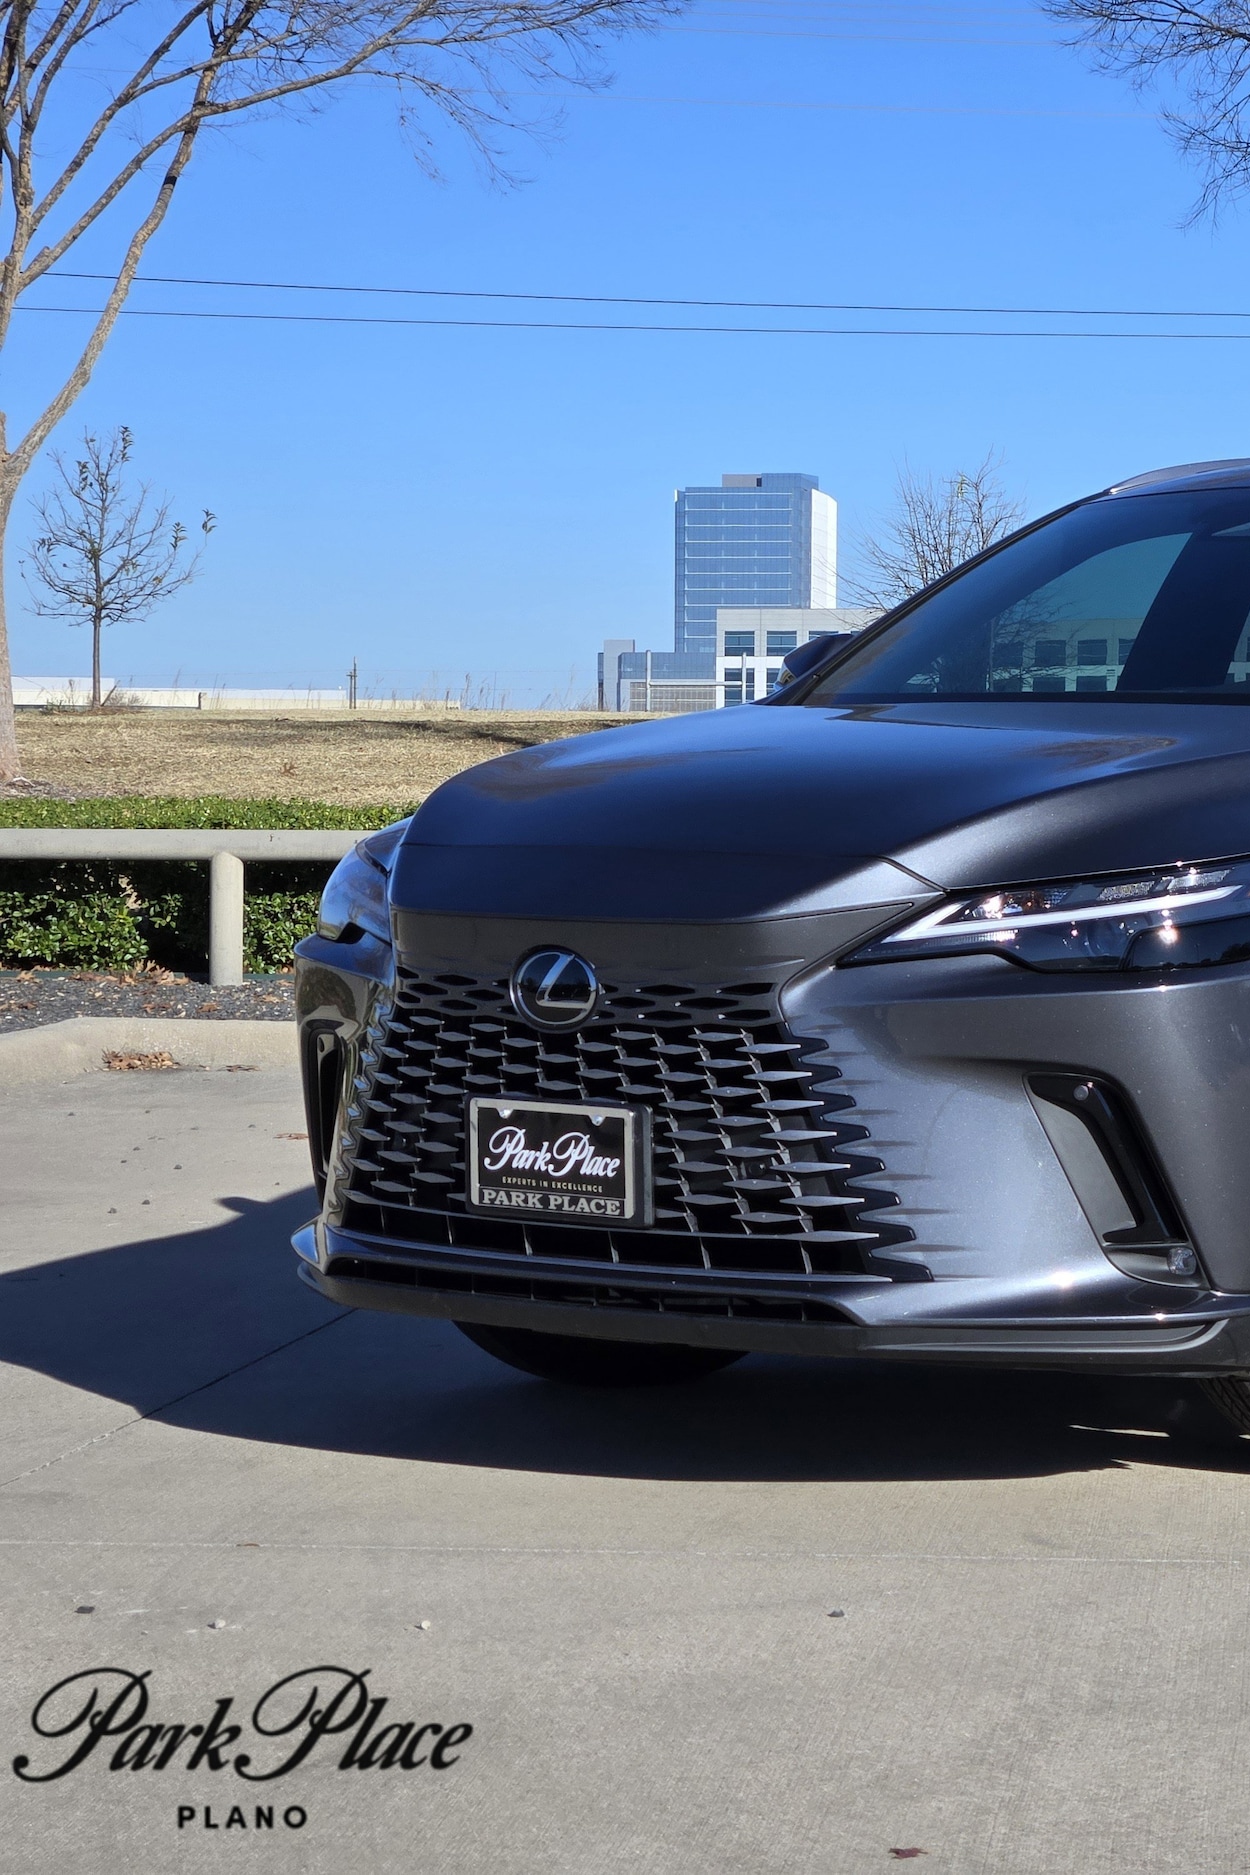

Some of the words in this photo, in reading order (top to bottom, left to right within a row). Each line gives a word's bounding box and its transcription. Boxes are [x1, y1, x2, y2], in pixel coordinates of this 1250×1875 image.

[484, 1126, 551, 1171] Park
[548, 1132, 620, 1177] Place
[502, 1176, 537, 1187] EXPERTS
[539, 1180, 548, 1188] IN
[552, 1181, 603, 1193] EXCELLENCE
[482, 1189, 545, 1209] PARK
[548, 1195, 621, 1216] PLACE
